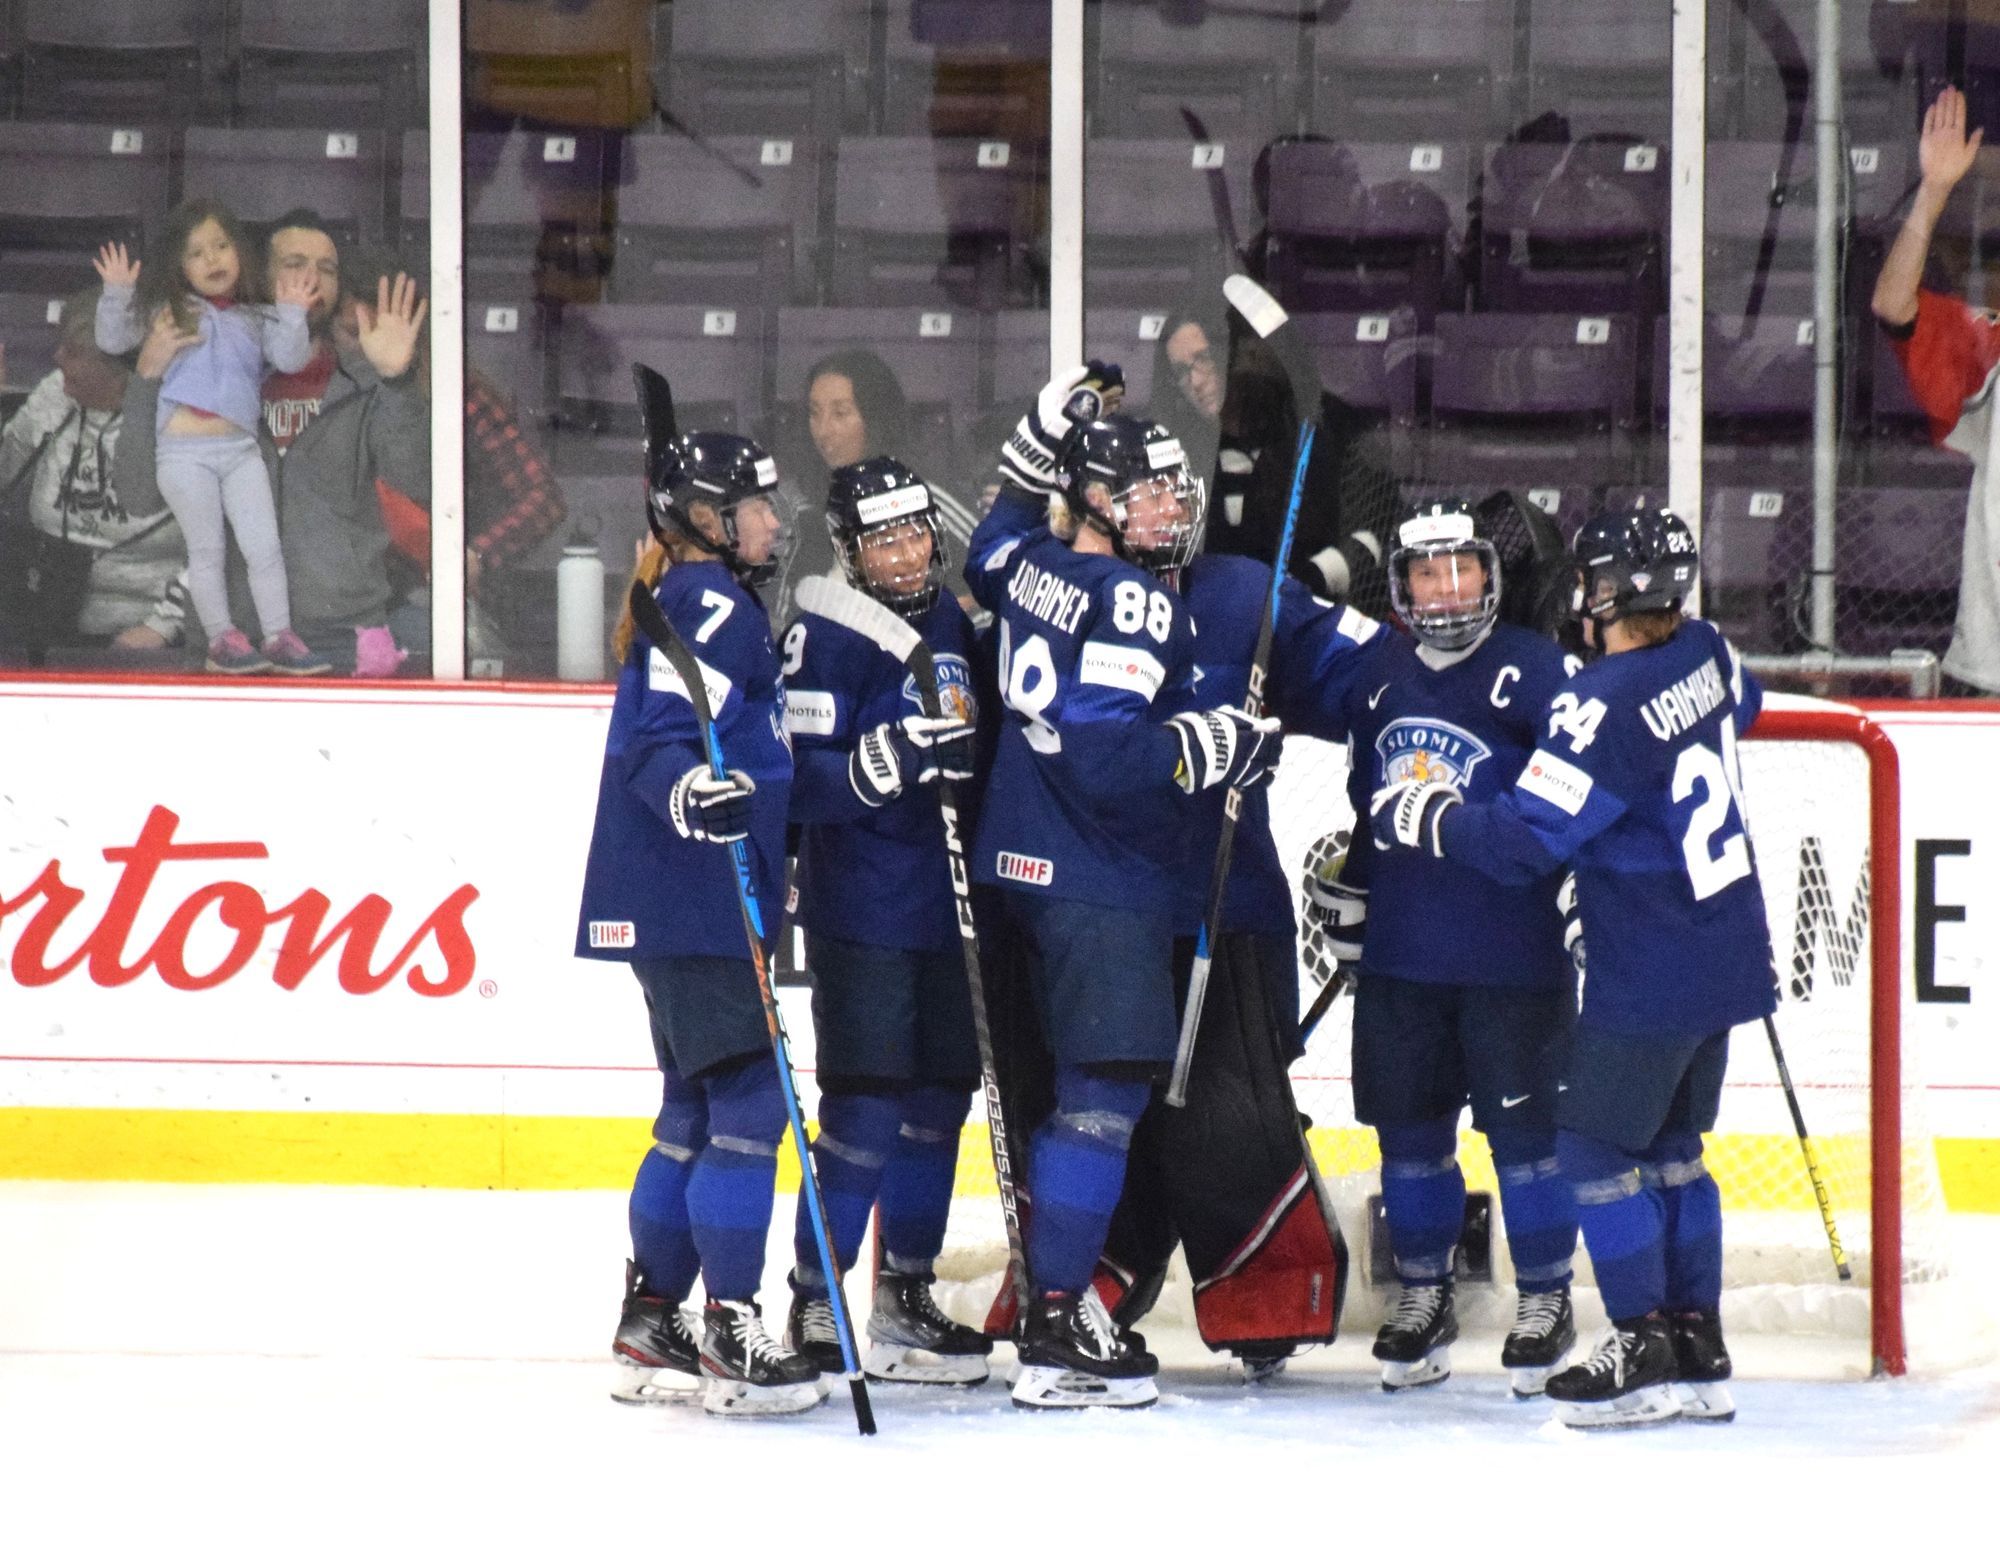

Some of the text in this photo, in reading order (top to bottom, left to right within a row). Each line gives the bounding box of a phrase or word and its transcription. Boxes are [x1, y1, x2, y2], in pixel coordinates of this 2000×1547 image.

[1758, 497, 1776, 512] 10
[1667, 531, 1690, 554] 24
[695, 589, 735, 644] 7
[1113, 580, 1172, 644] 88
[788, 706, 833, 719] HOTELS
[1490, 665, 1522, 710] C
[1387, 729, 1461, 758] SUOMI
[1549, 692, 1608, 755] 24
[0, 804, 480, 998] rtons
[986, 1082, 1020, 1230] JETSPEED
